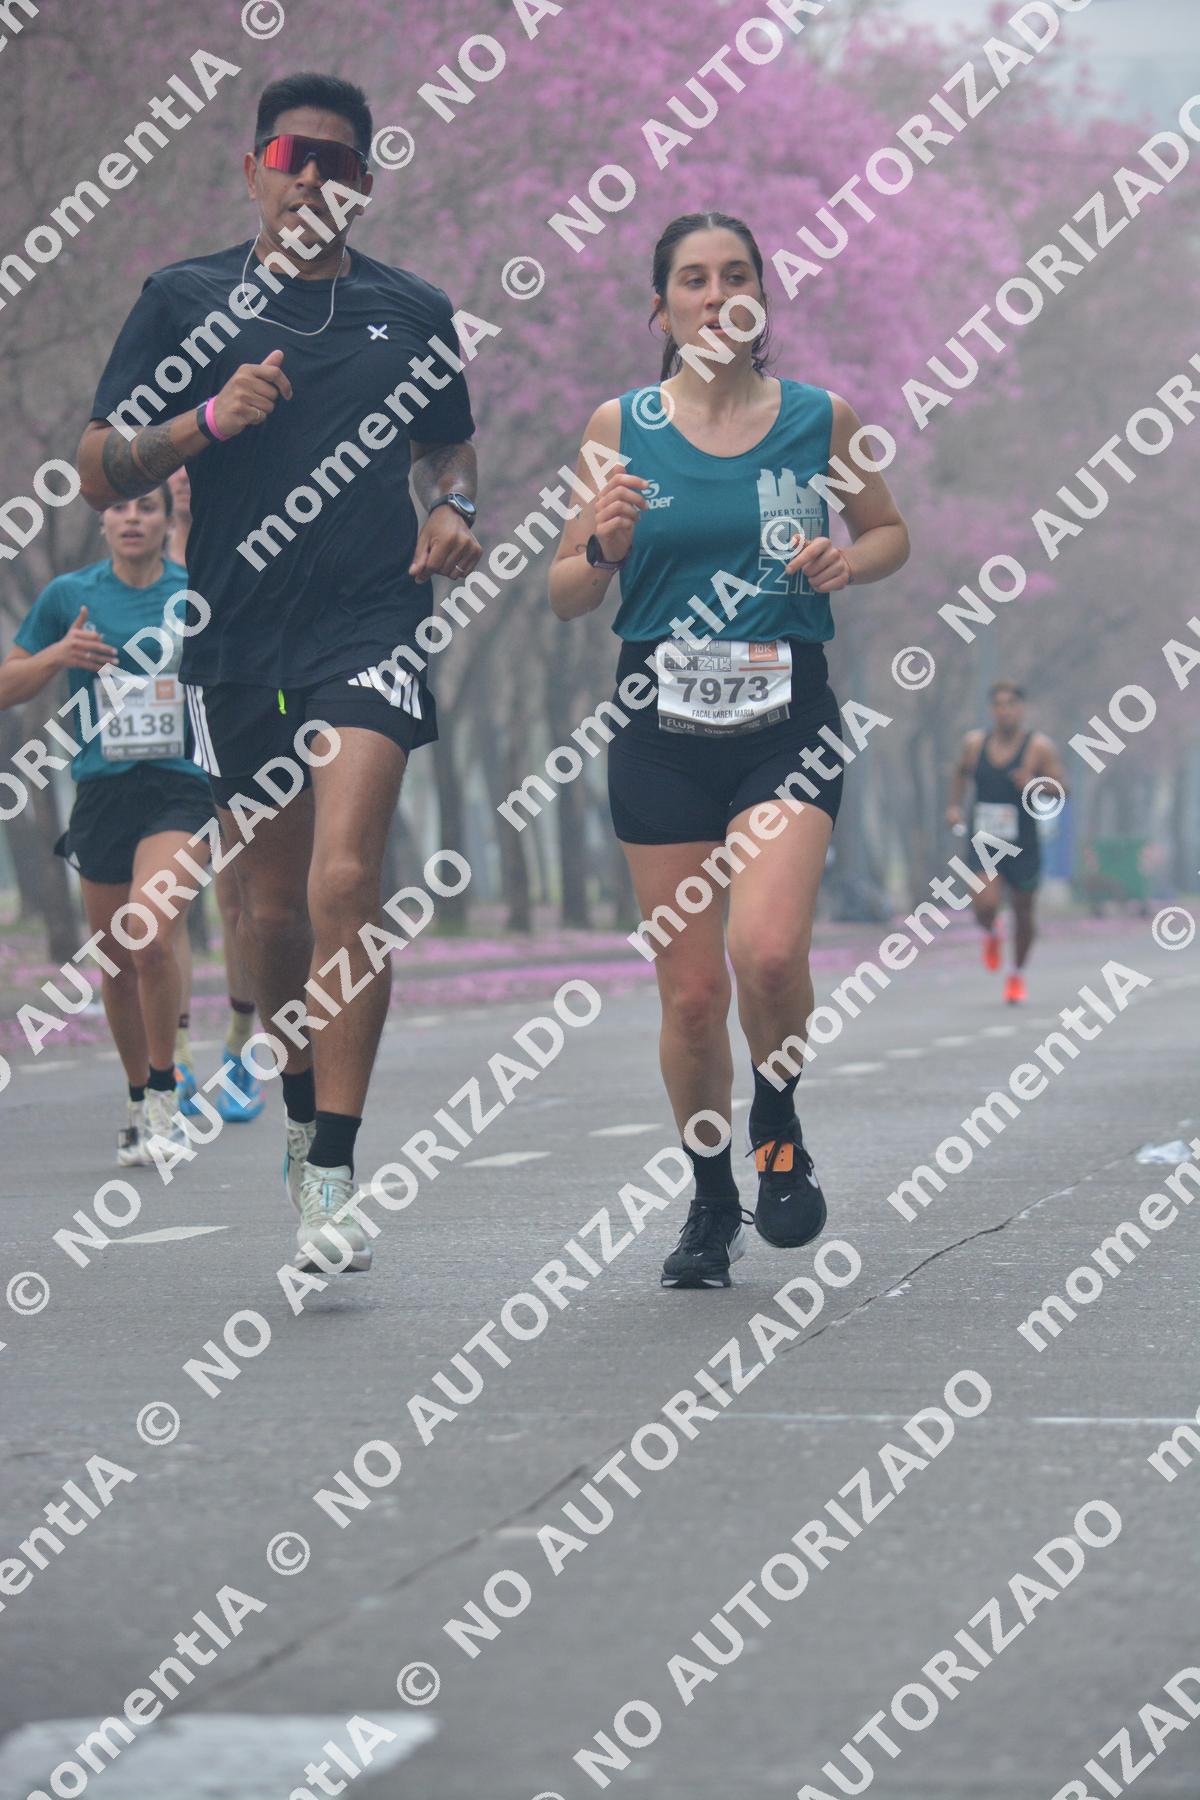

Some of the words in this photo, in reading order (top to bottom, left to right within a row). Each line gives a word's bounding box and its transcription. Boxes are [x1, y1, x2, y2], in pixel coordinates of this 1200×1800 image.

[763, 508, 802, 518] PUERTO
[677, 676, 769, 705] 7973
[713, 709, 733, 719] KAREN
[108, 713, 175, 738] 8138
